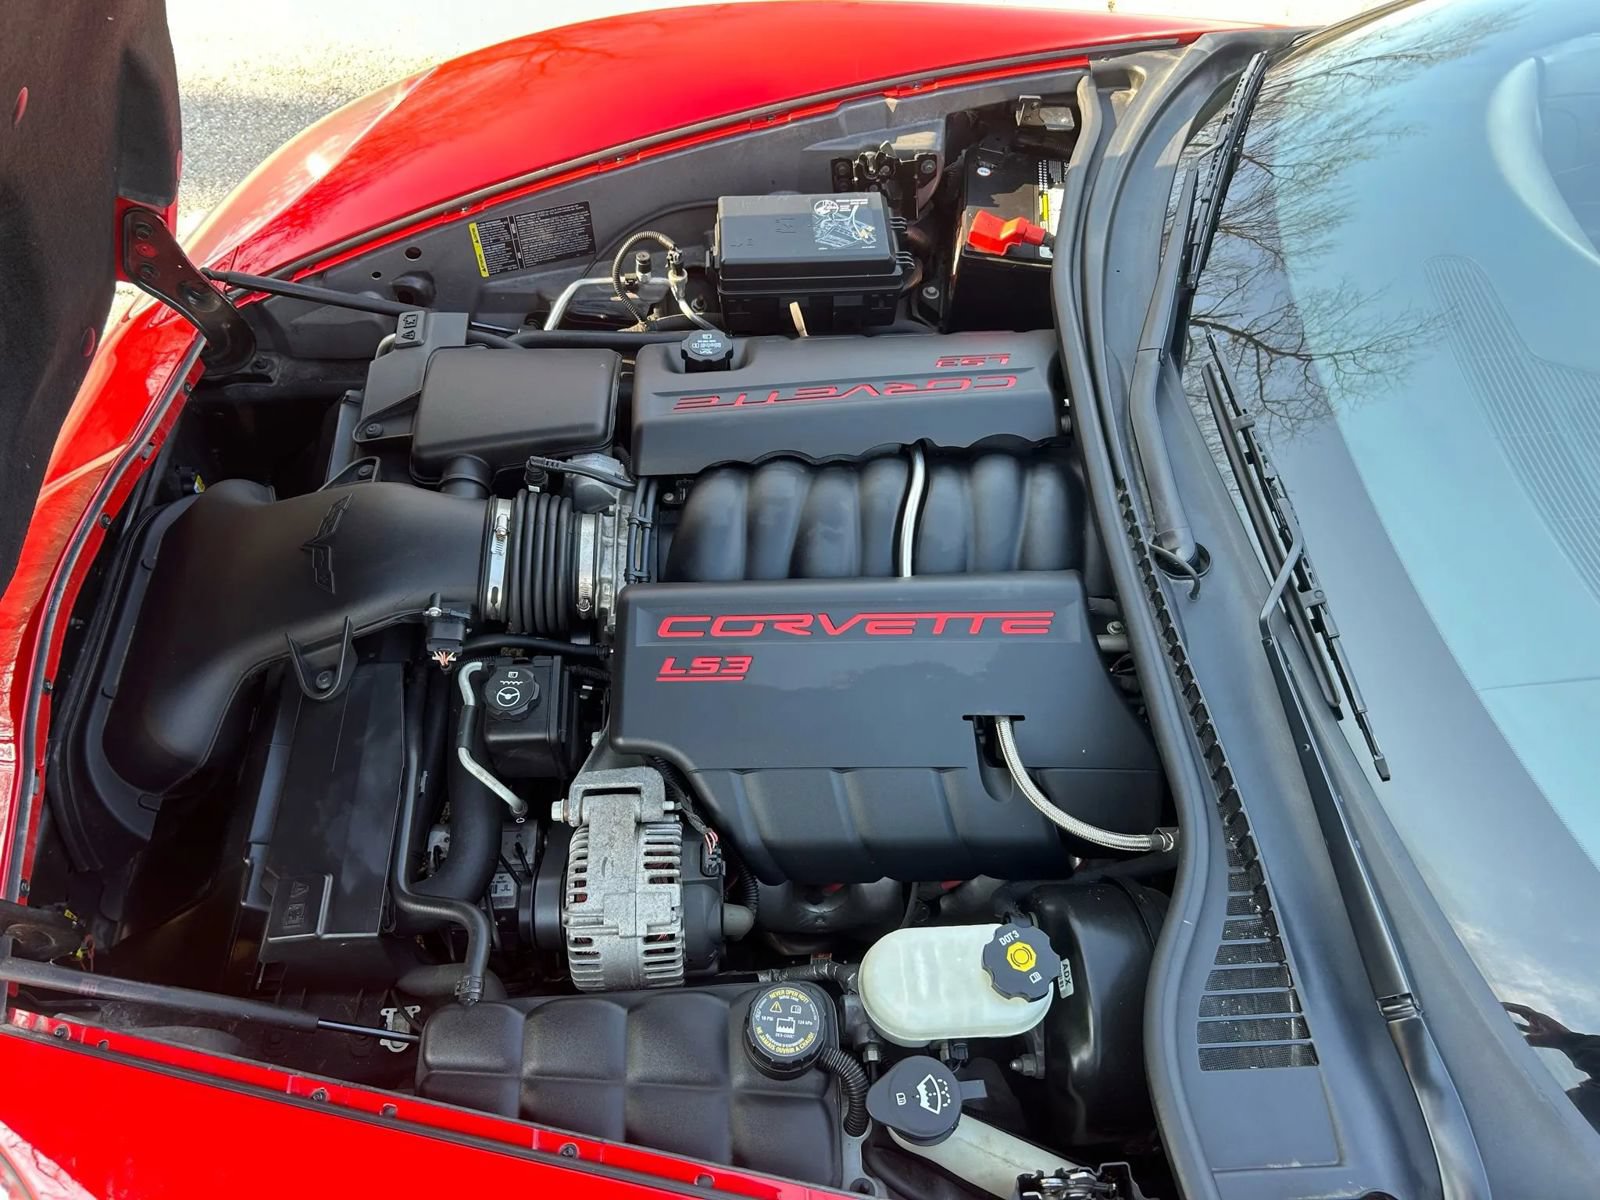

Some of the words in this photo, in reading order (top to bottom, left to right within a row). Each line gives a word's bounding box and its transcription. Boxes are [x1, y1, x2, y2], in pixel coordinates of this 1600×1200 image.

[935, 353, 1011, 368] LS3
[673, 374, 1018, 410] CORVETTE
[656, 611, 1055, 638] CORVETTE
[656, 655, 753, 677] LS3
[1062, 963, 1072, 986] ADX
[769, 989, 785, 999] NEVER
[785, 989, 799, 998] OPEN
